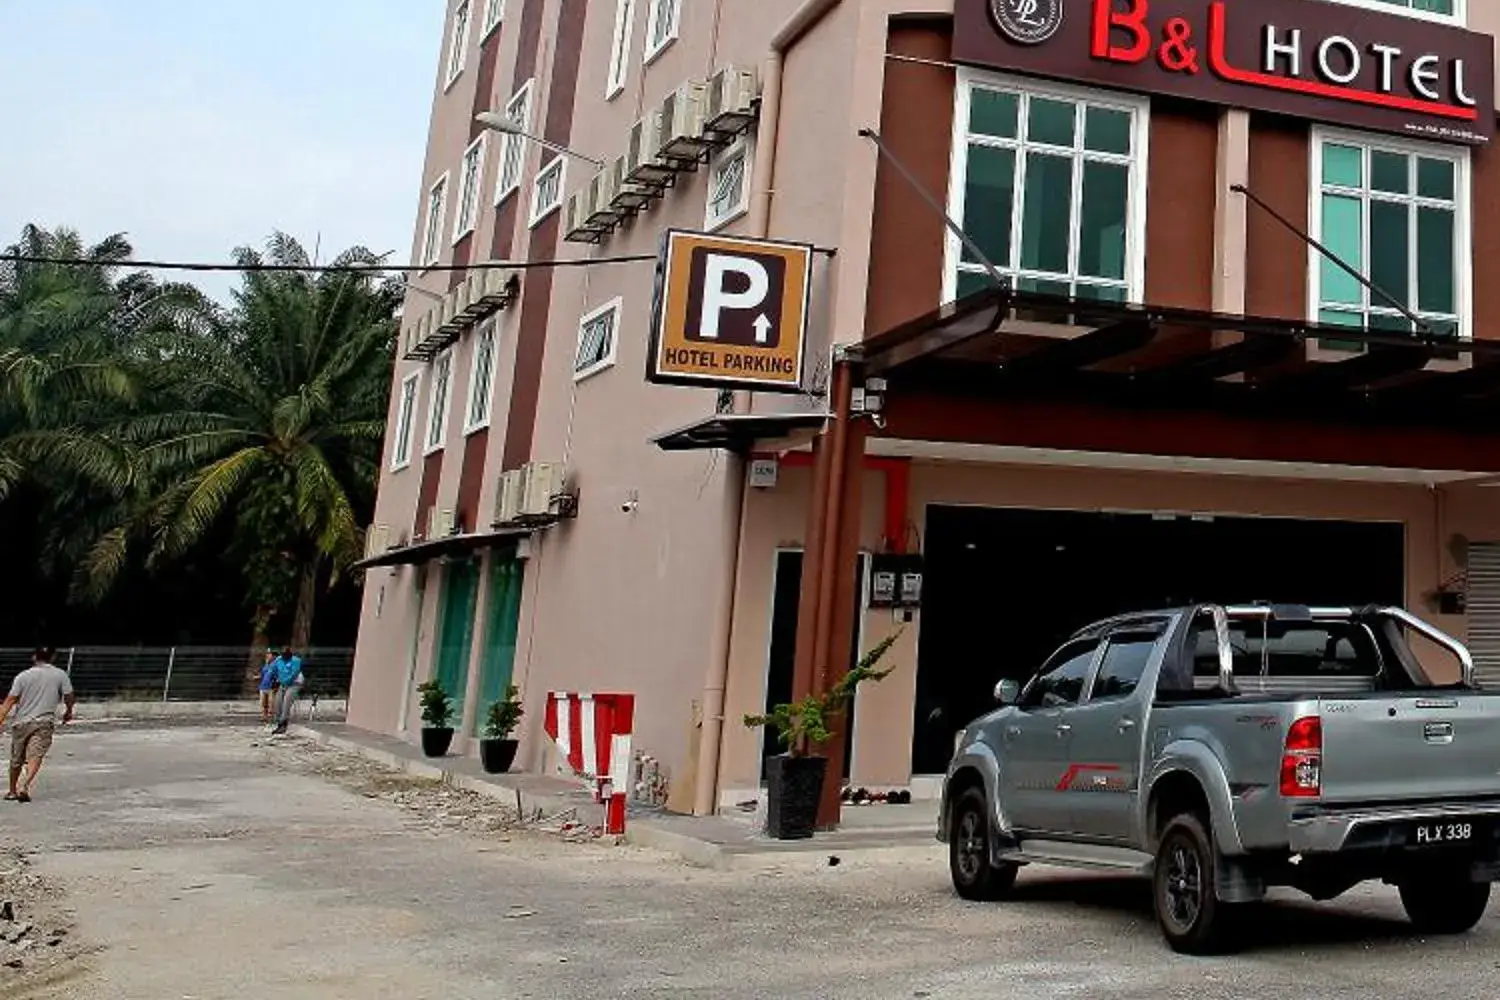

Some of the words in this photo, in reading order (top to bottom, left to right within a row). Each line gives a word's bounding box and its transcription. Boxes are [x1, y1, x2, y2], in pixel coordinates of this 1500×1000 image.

[1265, 24, 1477, 106] HOTEL
[700, 253, 769, 338] P
[665, 348, 718, 368] HOTEL
[723, 353, 793, 374] PARKING
[1417, 825, 1443, 843] PLX
[1446, 823, 1472, 840] 338
